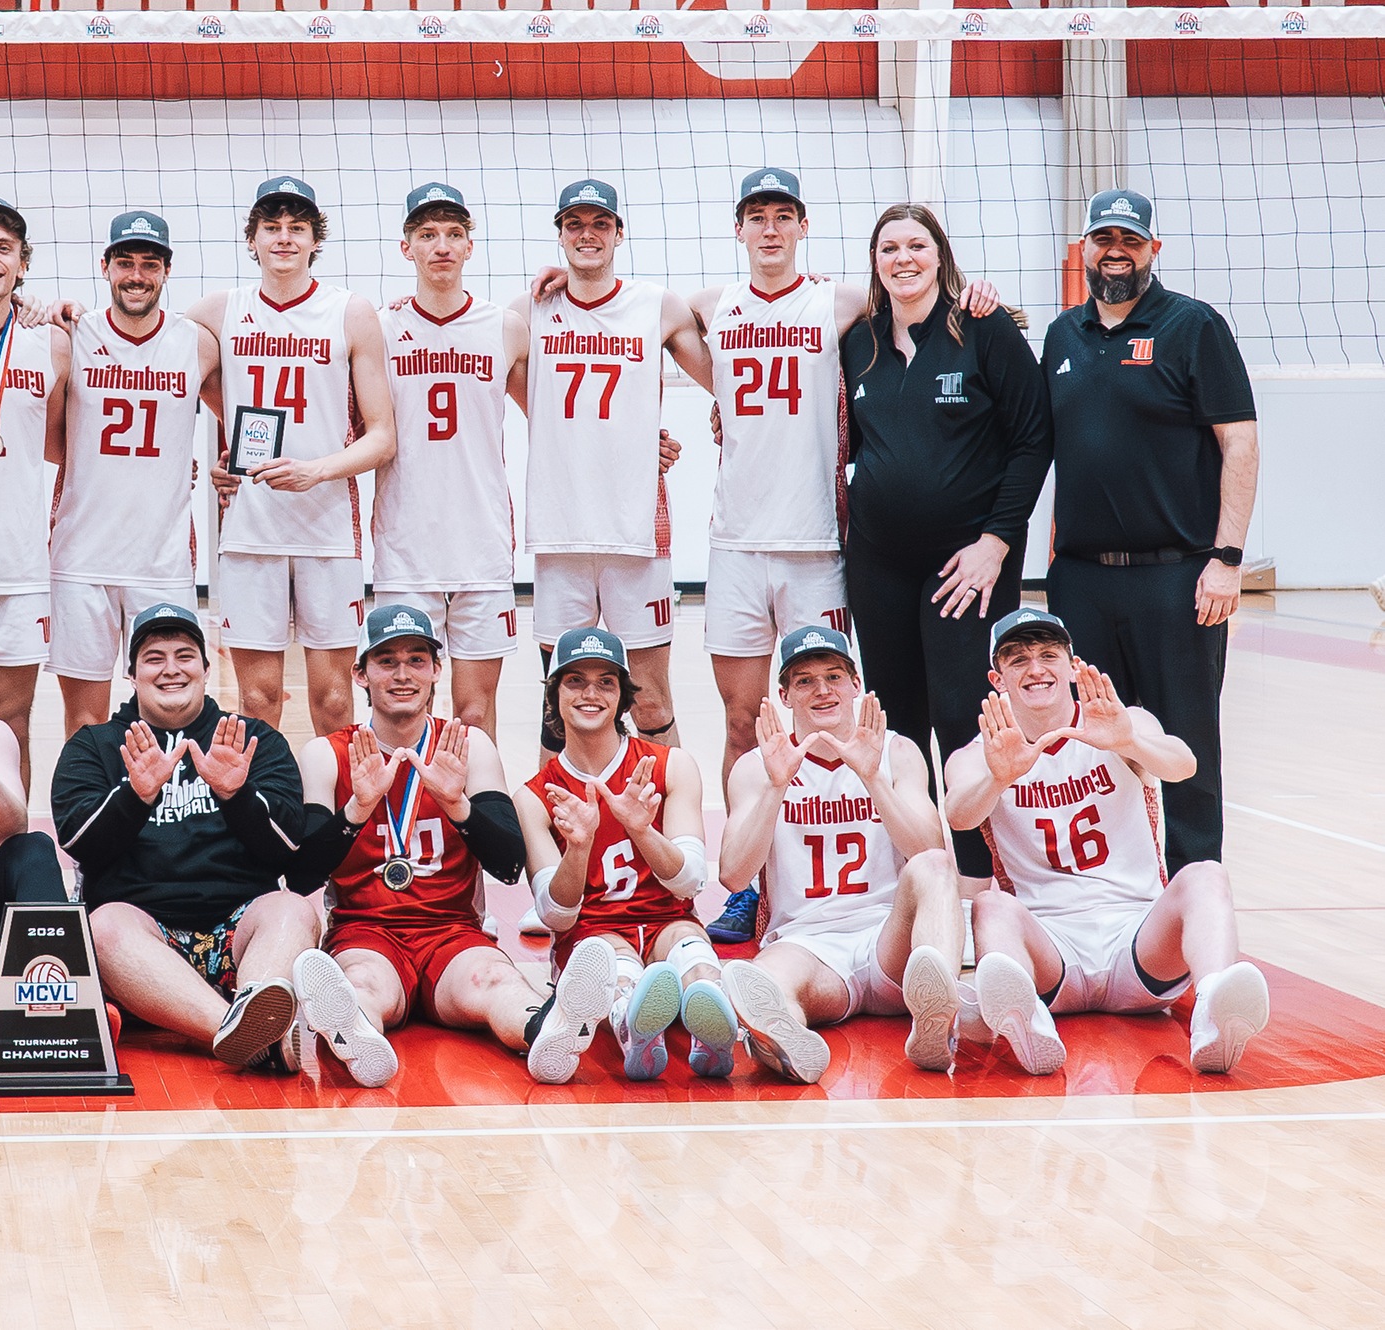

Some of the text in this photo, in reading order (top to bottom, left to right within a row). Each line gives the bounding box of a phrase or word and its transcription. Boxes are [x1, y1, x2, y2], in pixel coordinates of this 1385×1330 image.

[87, 26, 113, 34] MCVL
[198, 26, 224, 34] MCVL
[418, 26, 444, 34] MCVL
[528, 25, 554, 34] MCVL
[636, 25, 662, 34] MCVL
[745, 25, 771, 34] MCVL
[854, 25, 879, 33] MCVL
[961, 23, 987, 32] MCVL
[1068, 23, 1093, 31] MCVL
[1174, 21, 1200, 30] MCVL
[1281, 21, 1307, 30] MCVL
[308, 26, 334, 35] MCVL
[732, 356, 802, 416] 24
[247, 365, 307, 424] 14
[555, 363, 621, 420] 77
[427, 382, 458, 441] 9
[100, 397, 161, 458] 21
[245, 429, 270, 440] MCVL
[148, 799, 219, 825] EYBALL
[1035, 804, 1109, 874] 16
[599, 838, 638, 902] 6
[804, 832, 869, 899] 12
[27, 927, 65, 936] 2026
[18, 985, 74, 1001] MCVL
[2, 1050, 90, 1059] CHAMPIONS
